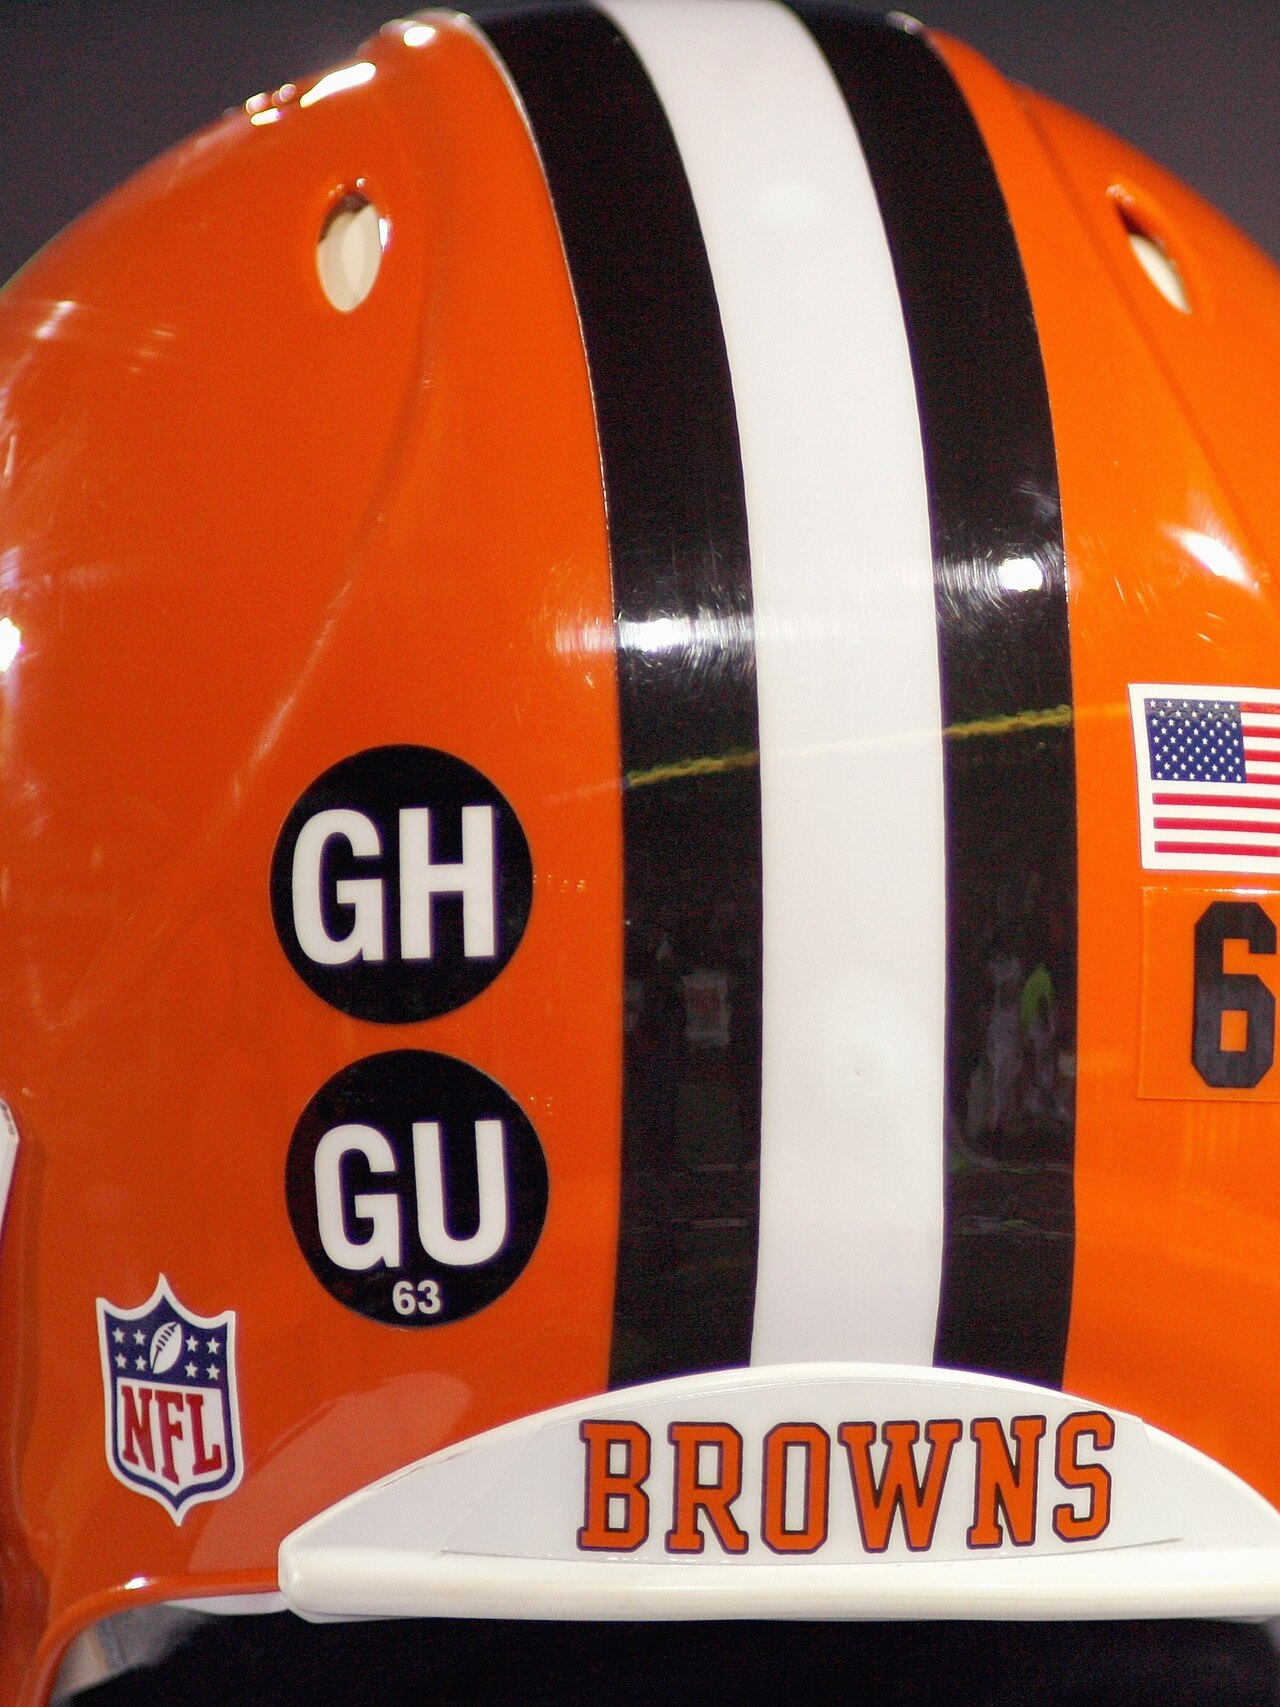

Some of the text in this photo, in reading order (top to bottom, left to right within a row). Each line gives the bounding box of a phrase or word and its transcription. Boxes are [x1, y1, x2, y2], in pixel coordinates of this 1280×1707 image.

[291, 805, 496, 966] GH
[313, 1119, 506, 1270] GU
[391, 1279, 442, 1316] 63
[120, 1384, 223, 1485] NFL
[577, 1410, 1116, 1555] BROWNS
